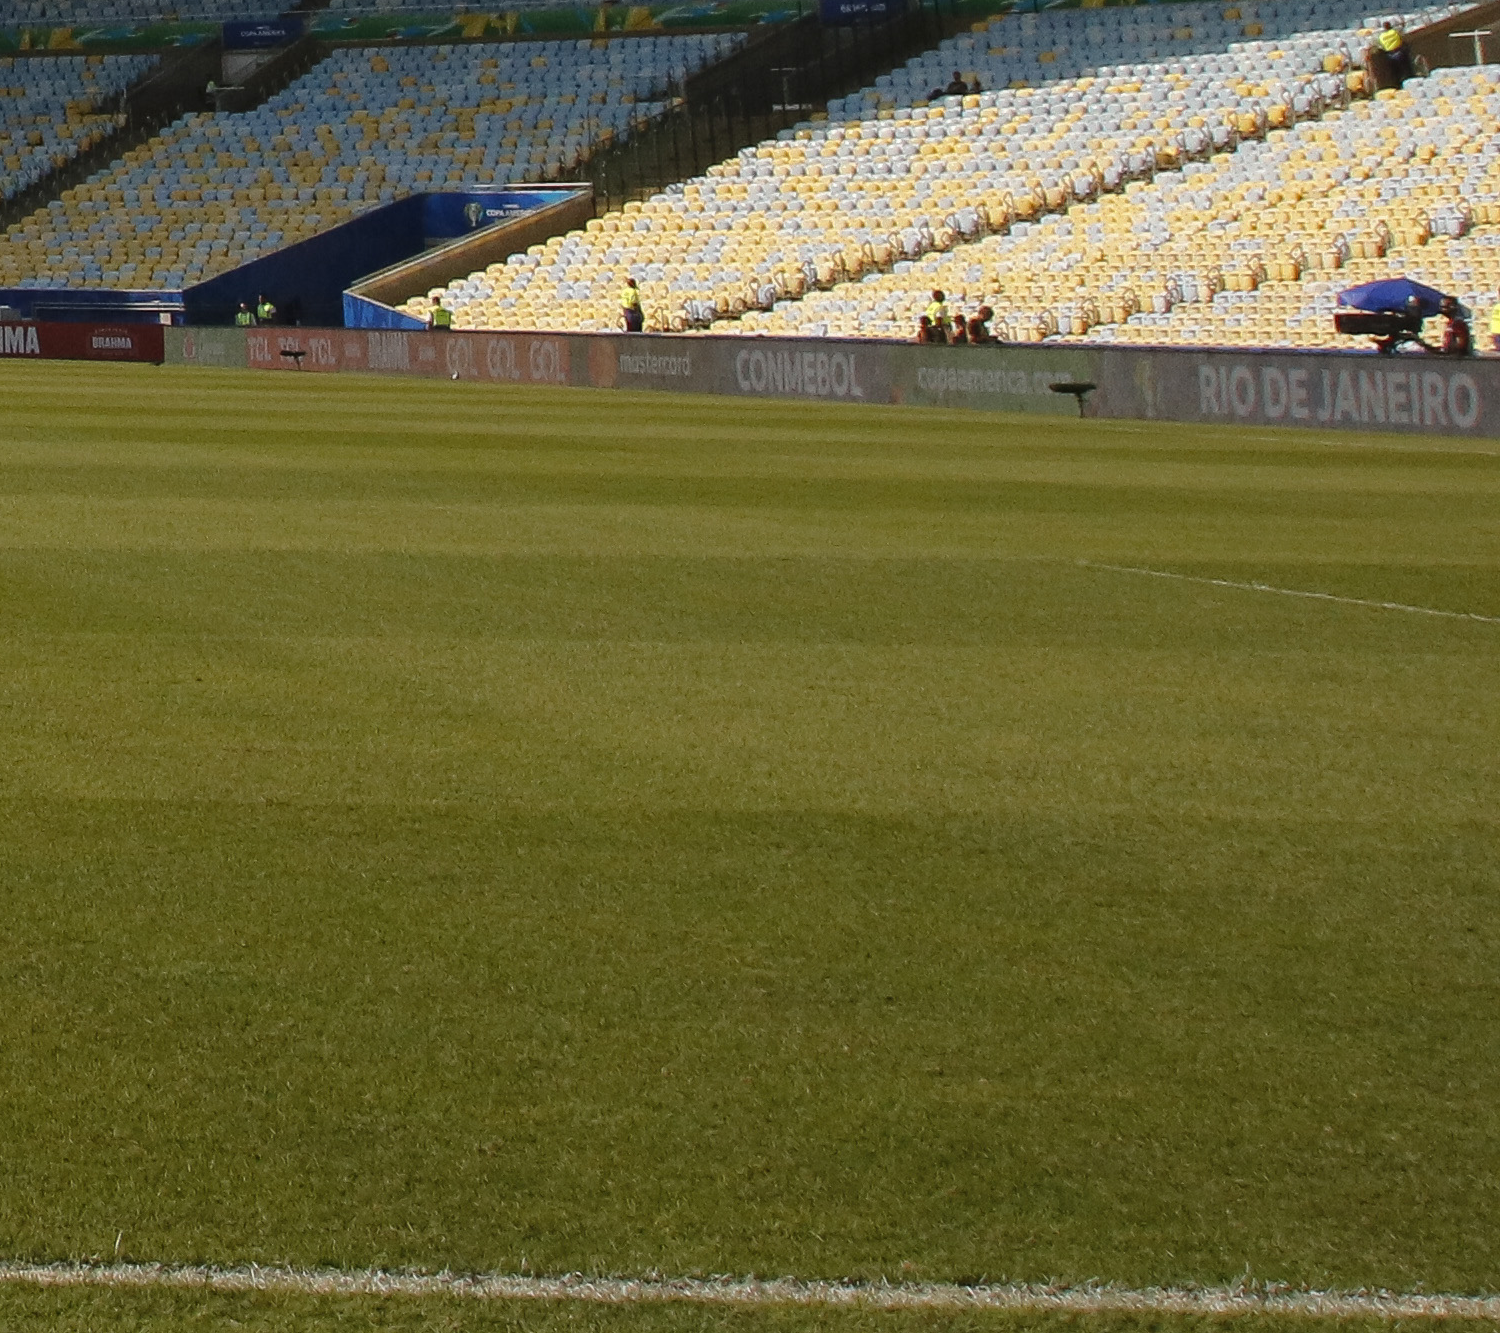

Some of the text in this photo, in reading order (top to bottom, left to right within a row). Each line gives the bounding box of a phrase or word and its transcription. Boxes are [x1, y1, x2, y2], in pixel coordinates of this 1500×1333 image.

[92, 336, 132, 350] BRAHMA
[247, 337, 272, 361] TCL
[308, 339, 337, 365] TCL
[445, 338, 479, 376] GOL
[485, 340, 521, 379] GOL
[528, 341, 567, 383] GOL
[619, 352, 691, 376] mastercard
[735, 349, 864, 397] CONMEBOL
[1201, 362, 1483, 429] RIO DE JANEIRO
